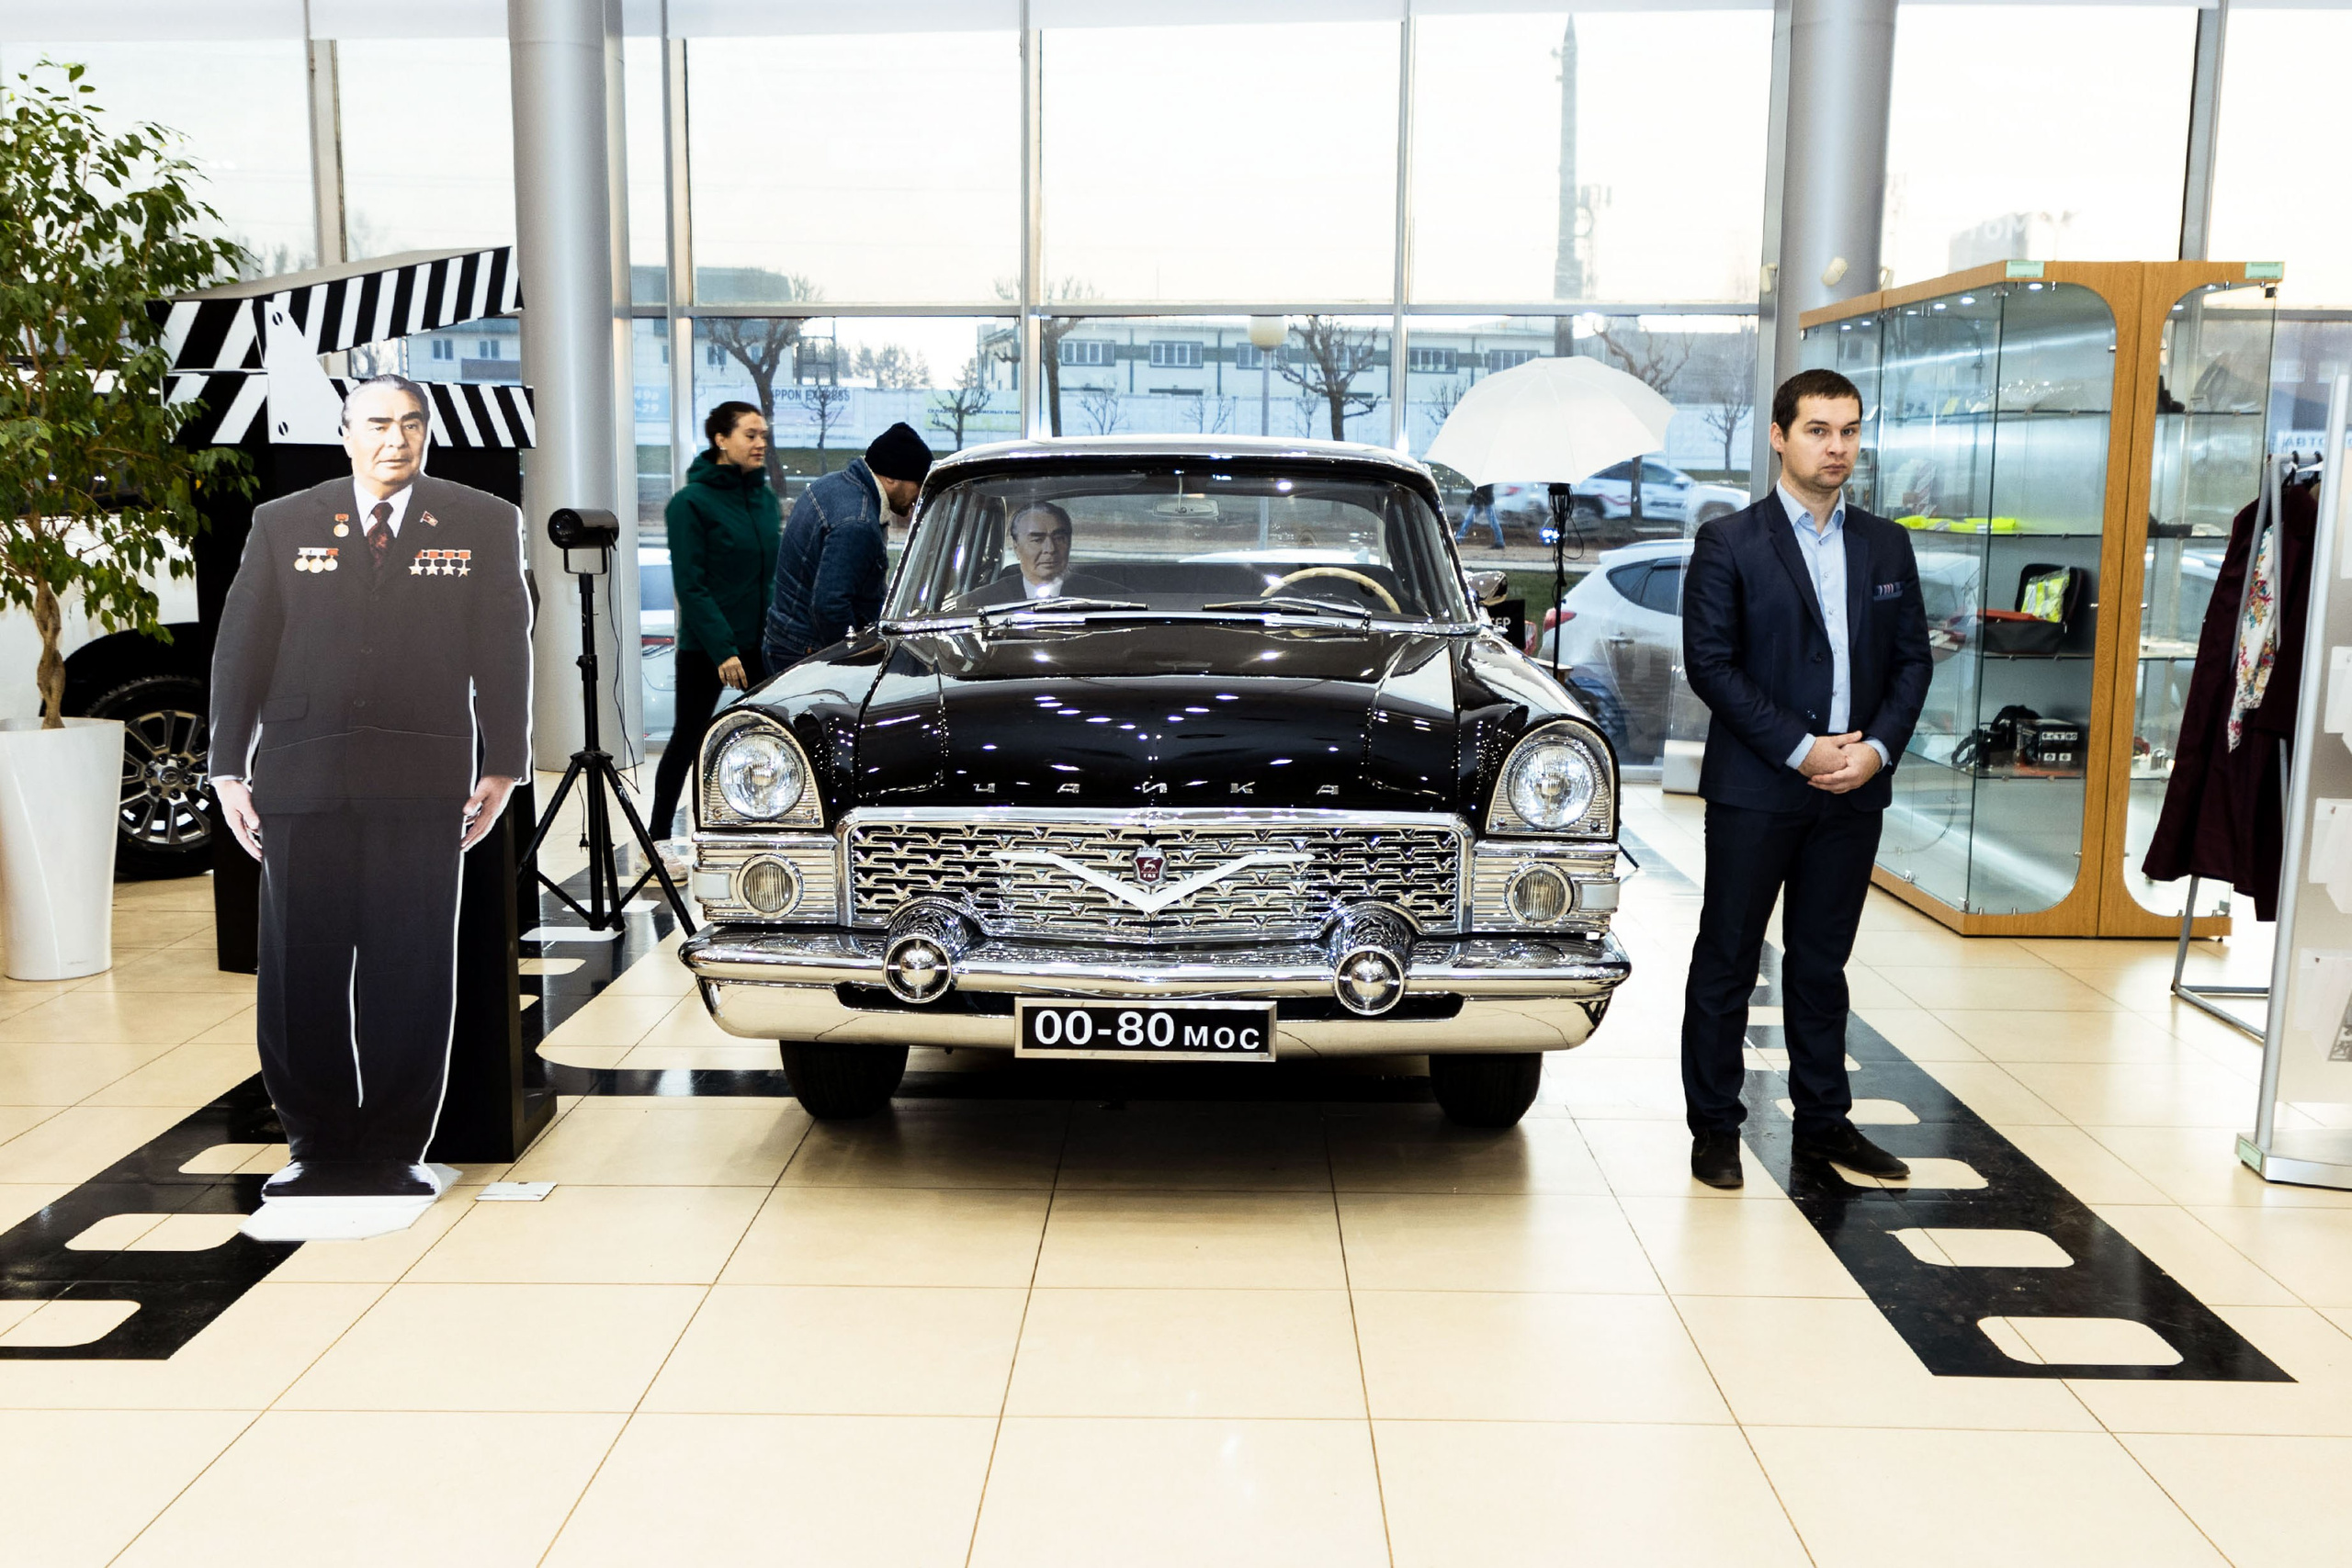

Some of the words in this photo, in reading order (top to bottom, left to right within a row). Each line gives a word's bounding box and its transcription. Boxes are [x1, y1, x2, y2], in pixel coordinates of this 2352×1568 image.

[772, 389, 802, 400] PPON
[1035, 1010, 1175, 1047] 00-80
[1183, 1025, 1260, 1050] МОС
